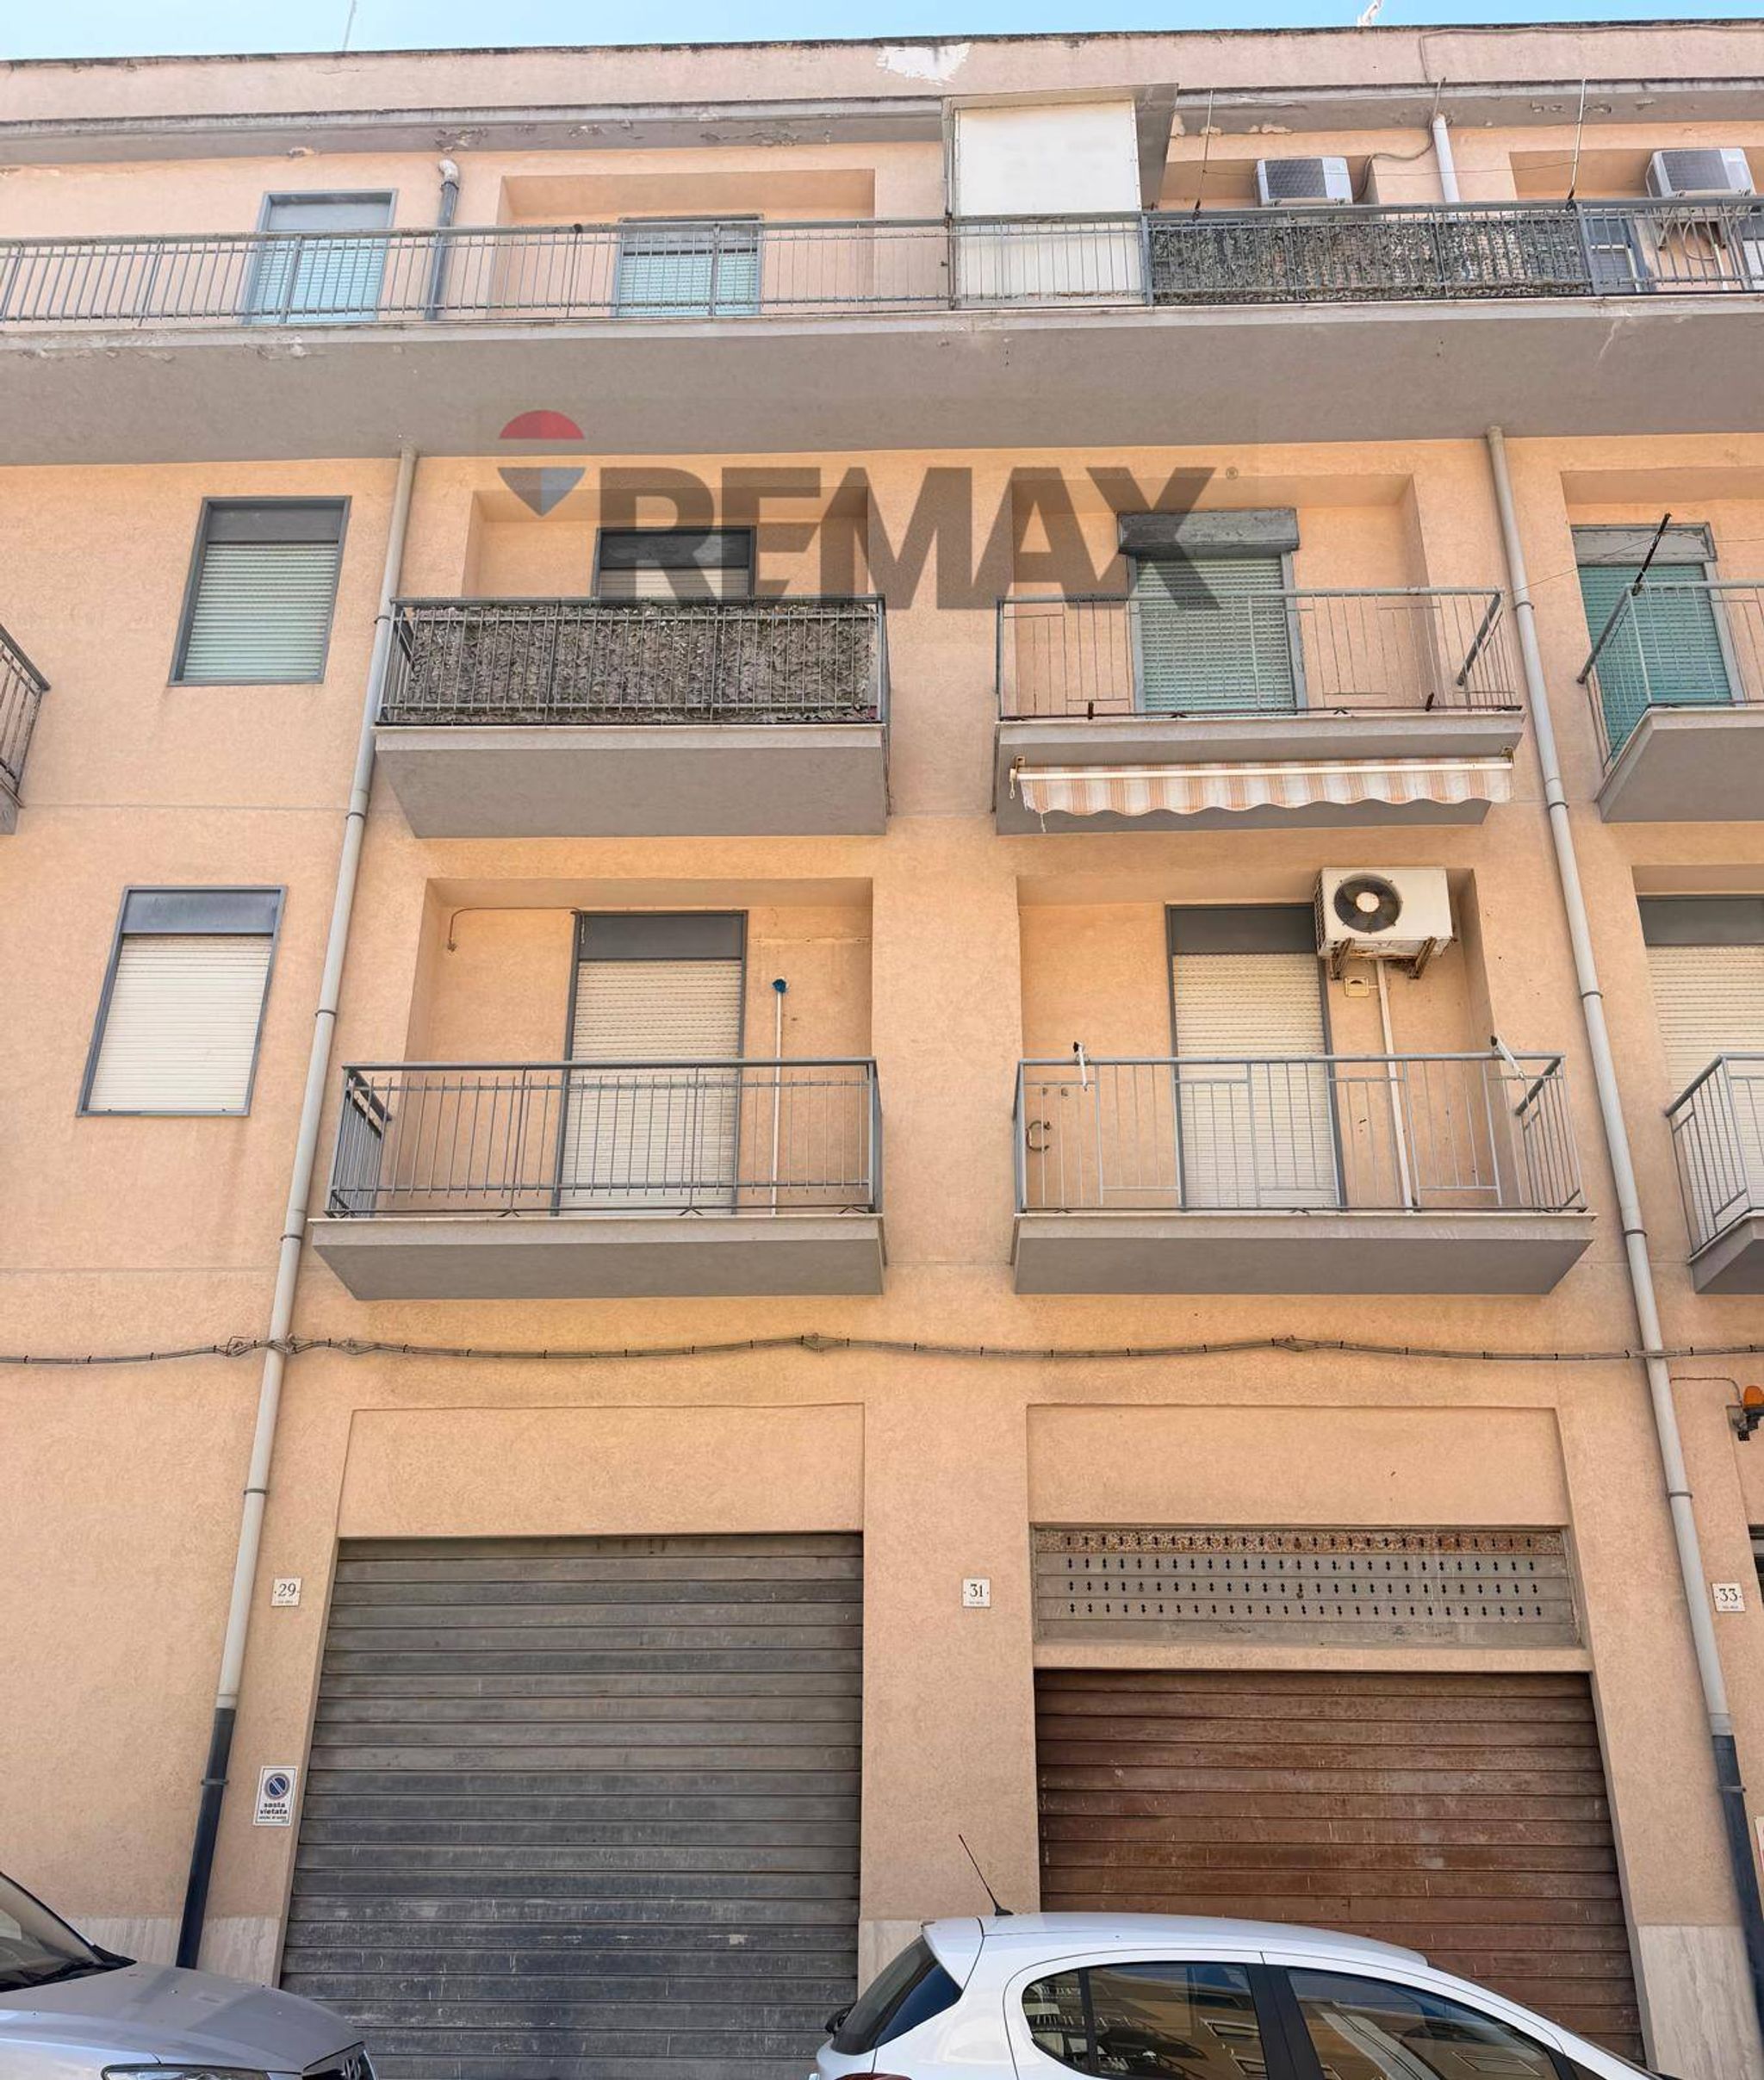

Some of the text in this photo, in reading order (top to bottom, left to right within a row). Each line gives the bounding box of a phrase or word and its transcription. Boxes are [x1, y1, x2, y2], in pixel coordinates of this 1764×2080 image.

[277, 1582, 296, 1597] 29
[970, 1583, 983, 1598] 31
[1718, 1587, 1738, 1602] 33
